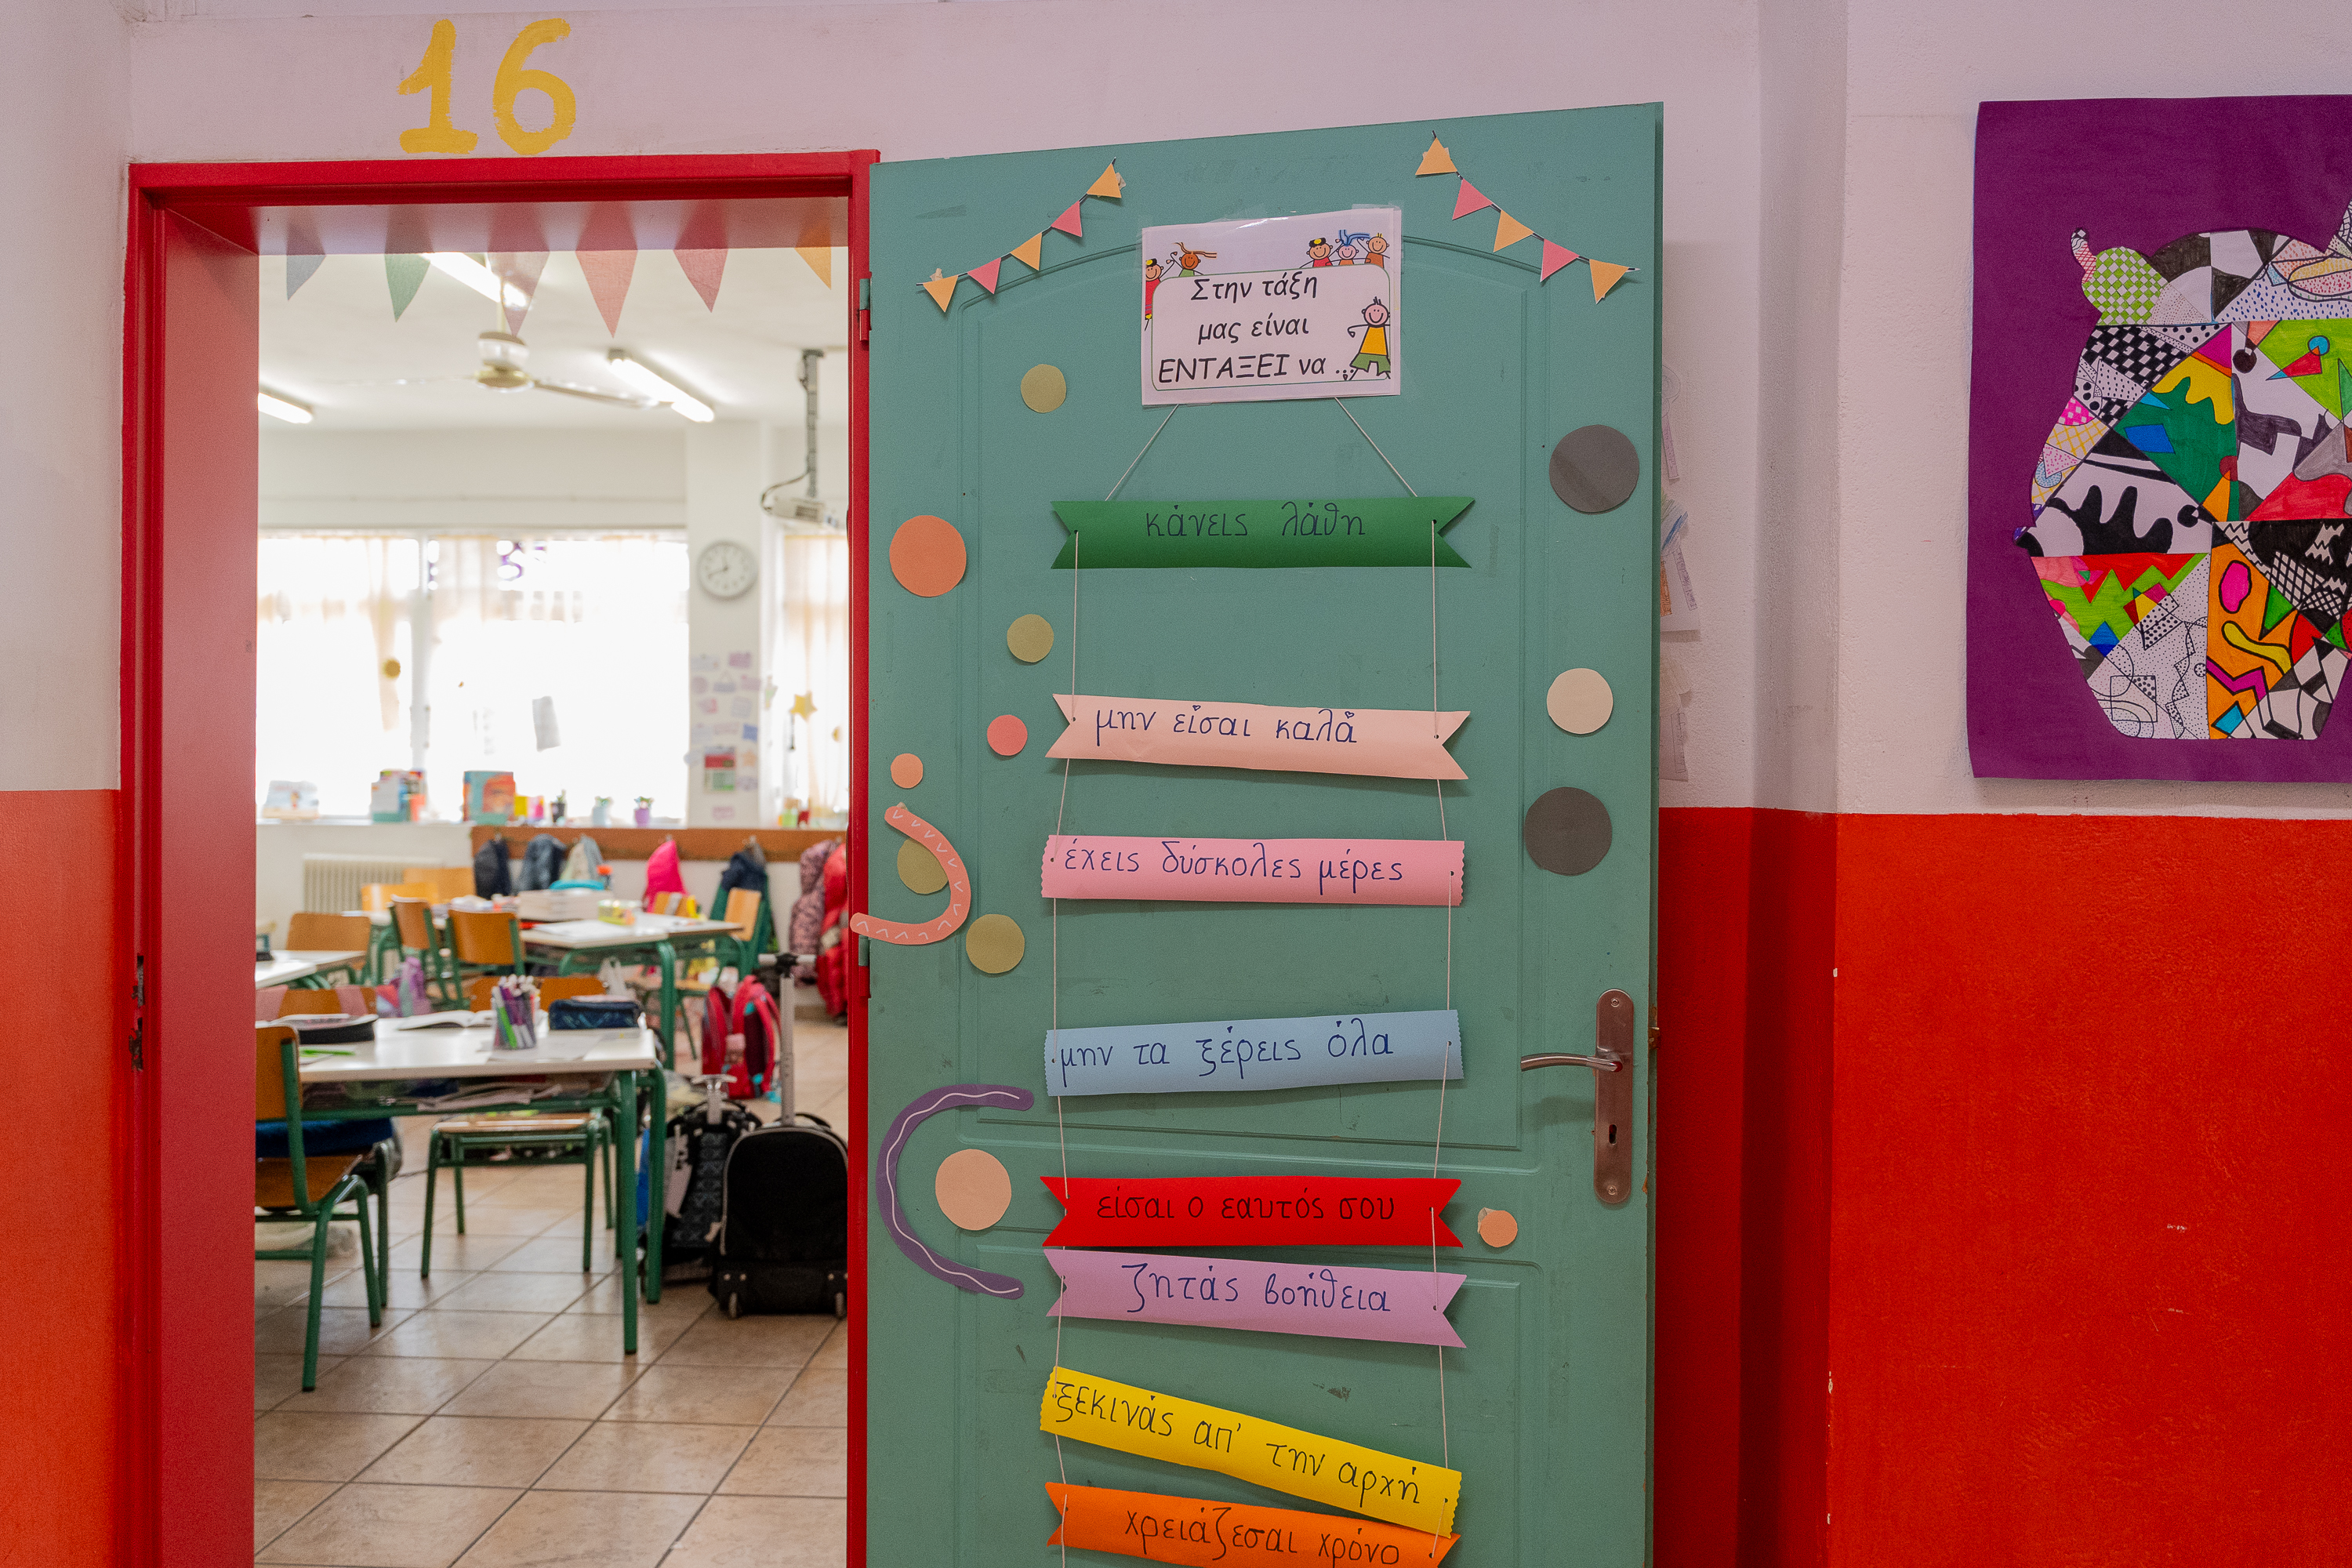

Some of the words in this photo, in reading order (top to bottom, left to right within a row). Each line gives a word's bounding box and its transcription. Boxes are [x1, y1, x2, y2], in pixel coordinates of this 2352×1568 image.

[397, 17, 576, 155] 16
[1191, 278, 1252, 303] Στην
[1262, 270, 1318, 300] τάξη
[1198, 321, 1241, 345] μας
[1251, 312, 1309, 338] είναι
[1159, 354, 1290, 383] ΕΝΤΑΞΕΙ
[1298, 358, 1326, 376] να
[1145, 504, 1248, 537] κάνεις
[1281, 501, 1366, 536] λάθη
[1097, 709, 1156, 747] μην
[1173, 705, 1251, 738] είσαι
[1276, 709, 1358, 744] καλά
[1064, 838, 1140, 873] έχεις
[1161, 840, 1302, 879] δύσκολες
[1318, 848, 1403, 895] μέρες
[1060, 1045, 1113, 1088] μην
[1134, 1043, 1171, 1065] τα
[1196, 1025, 1301, 1079] ξέρεις
[1327, 1018, 1394, 1057] όλα
[1097, 1185, 1174, 1219] είσαι
[1187, 1196, 1204, 1218] ο
[1221, 1188, 1324, 1220] εαυτός
[1339, 1196, 1395, 1220] σου
[1121, 1262, 1239, 1313] ζητάς
[1265, 1269, 1391, 1312] βοήθεια
[1055, 1381, 1173, 1437] ξεκινάς
[1266, 1443, 1326, 1476] την
[1338, 1461, 1421, 1508] αρχή
[1124, 1506, 1298, 1561] χρειάζεσαι
[1318, 1527, 1400, 1568] χρόνο
